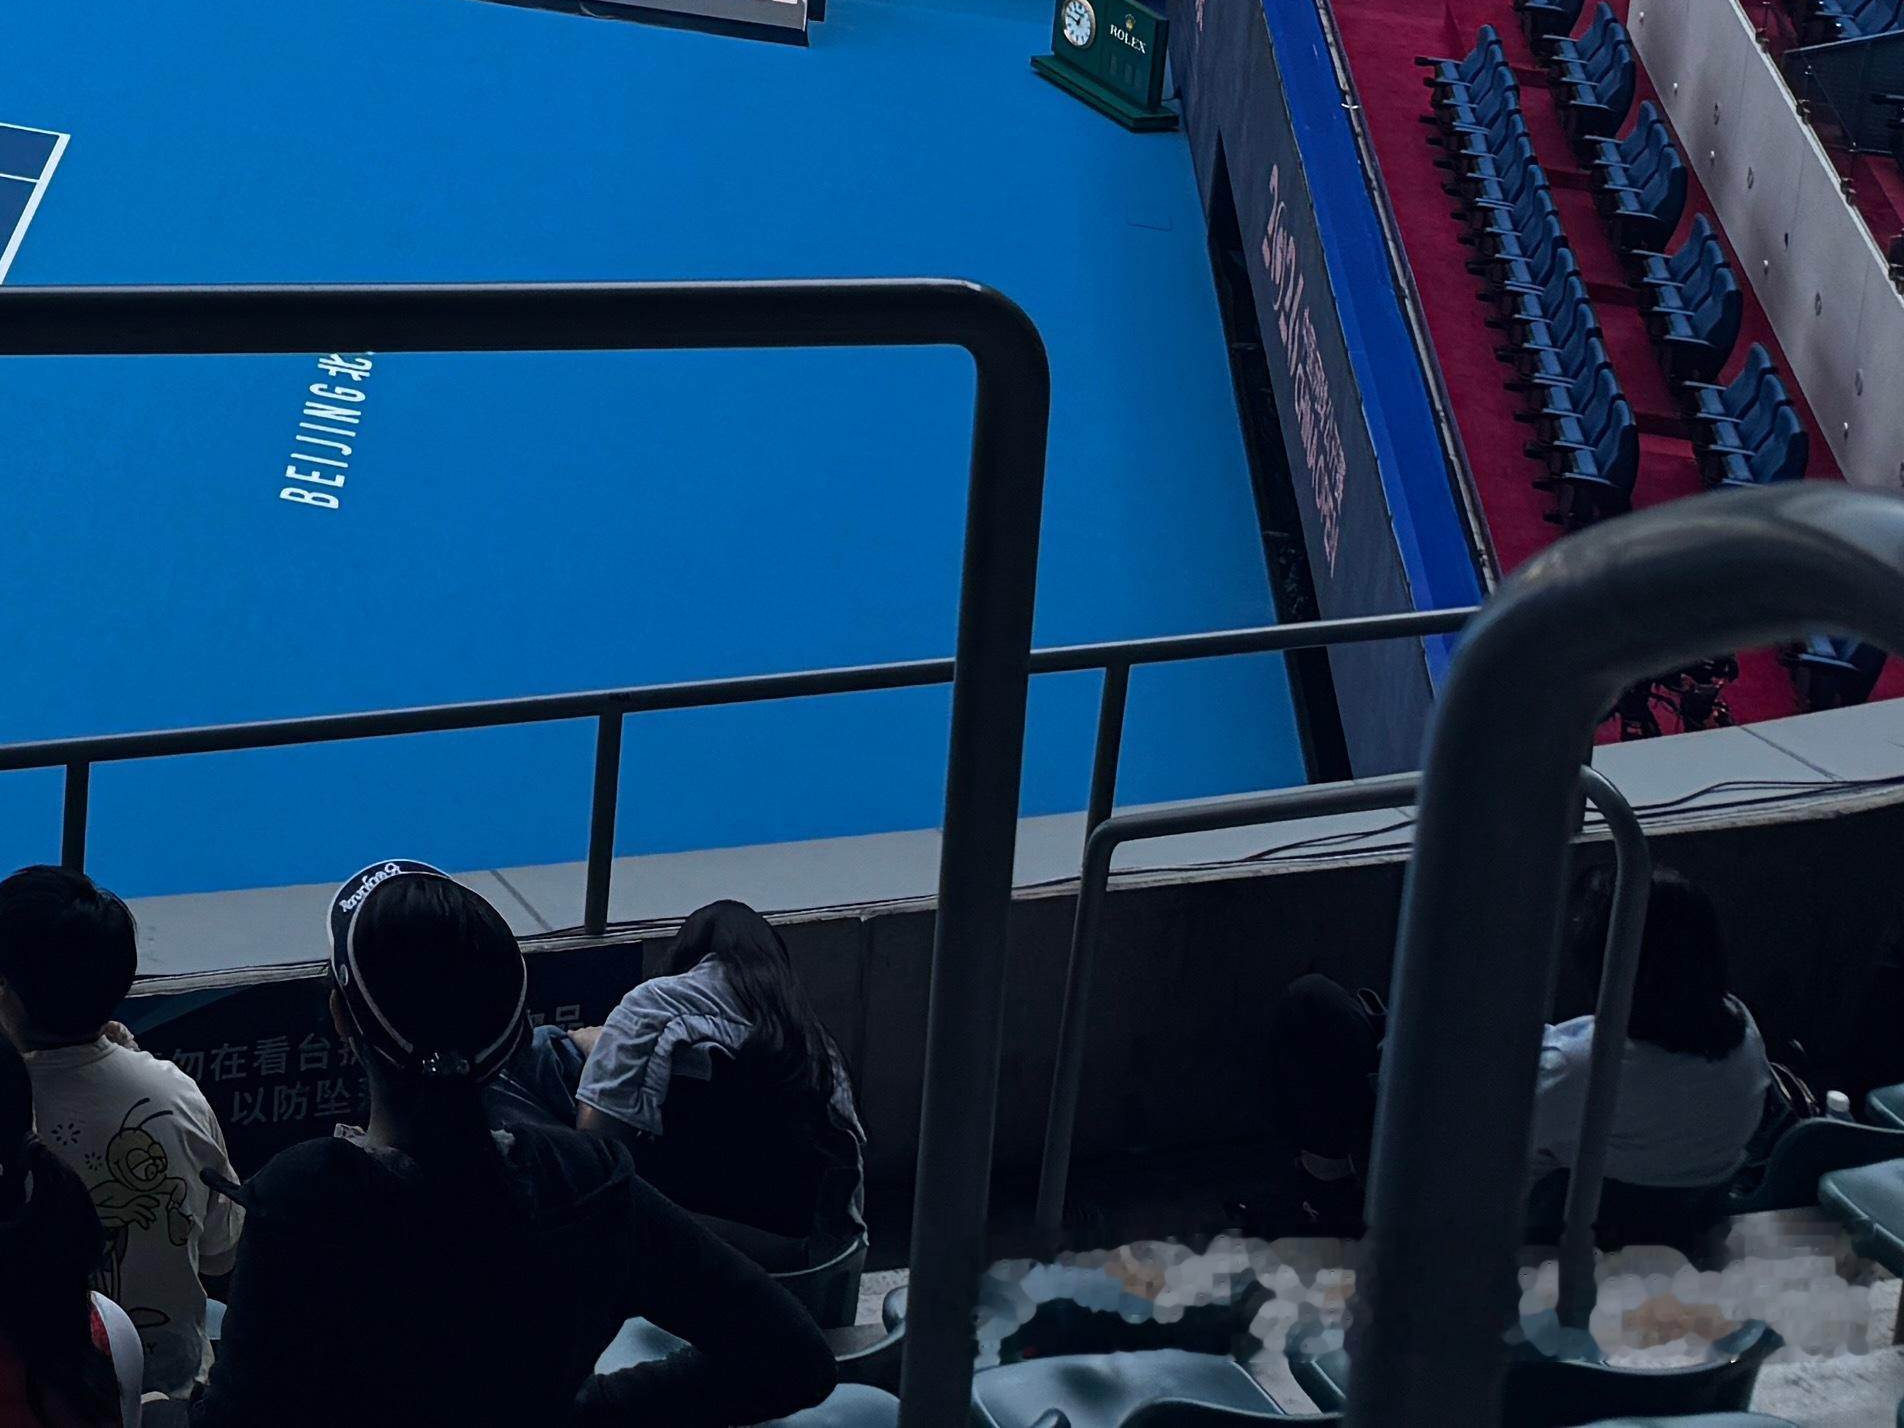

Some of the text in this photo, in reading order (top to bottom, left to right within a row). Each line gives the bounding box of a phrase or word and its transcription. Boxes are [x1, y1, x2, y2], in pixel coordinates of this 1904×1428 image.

[1110, 23, 1147, 55] ROLEX
[280, 351, 373, 510] BEIJING 北
